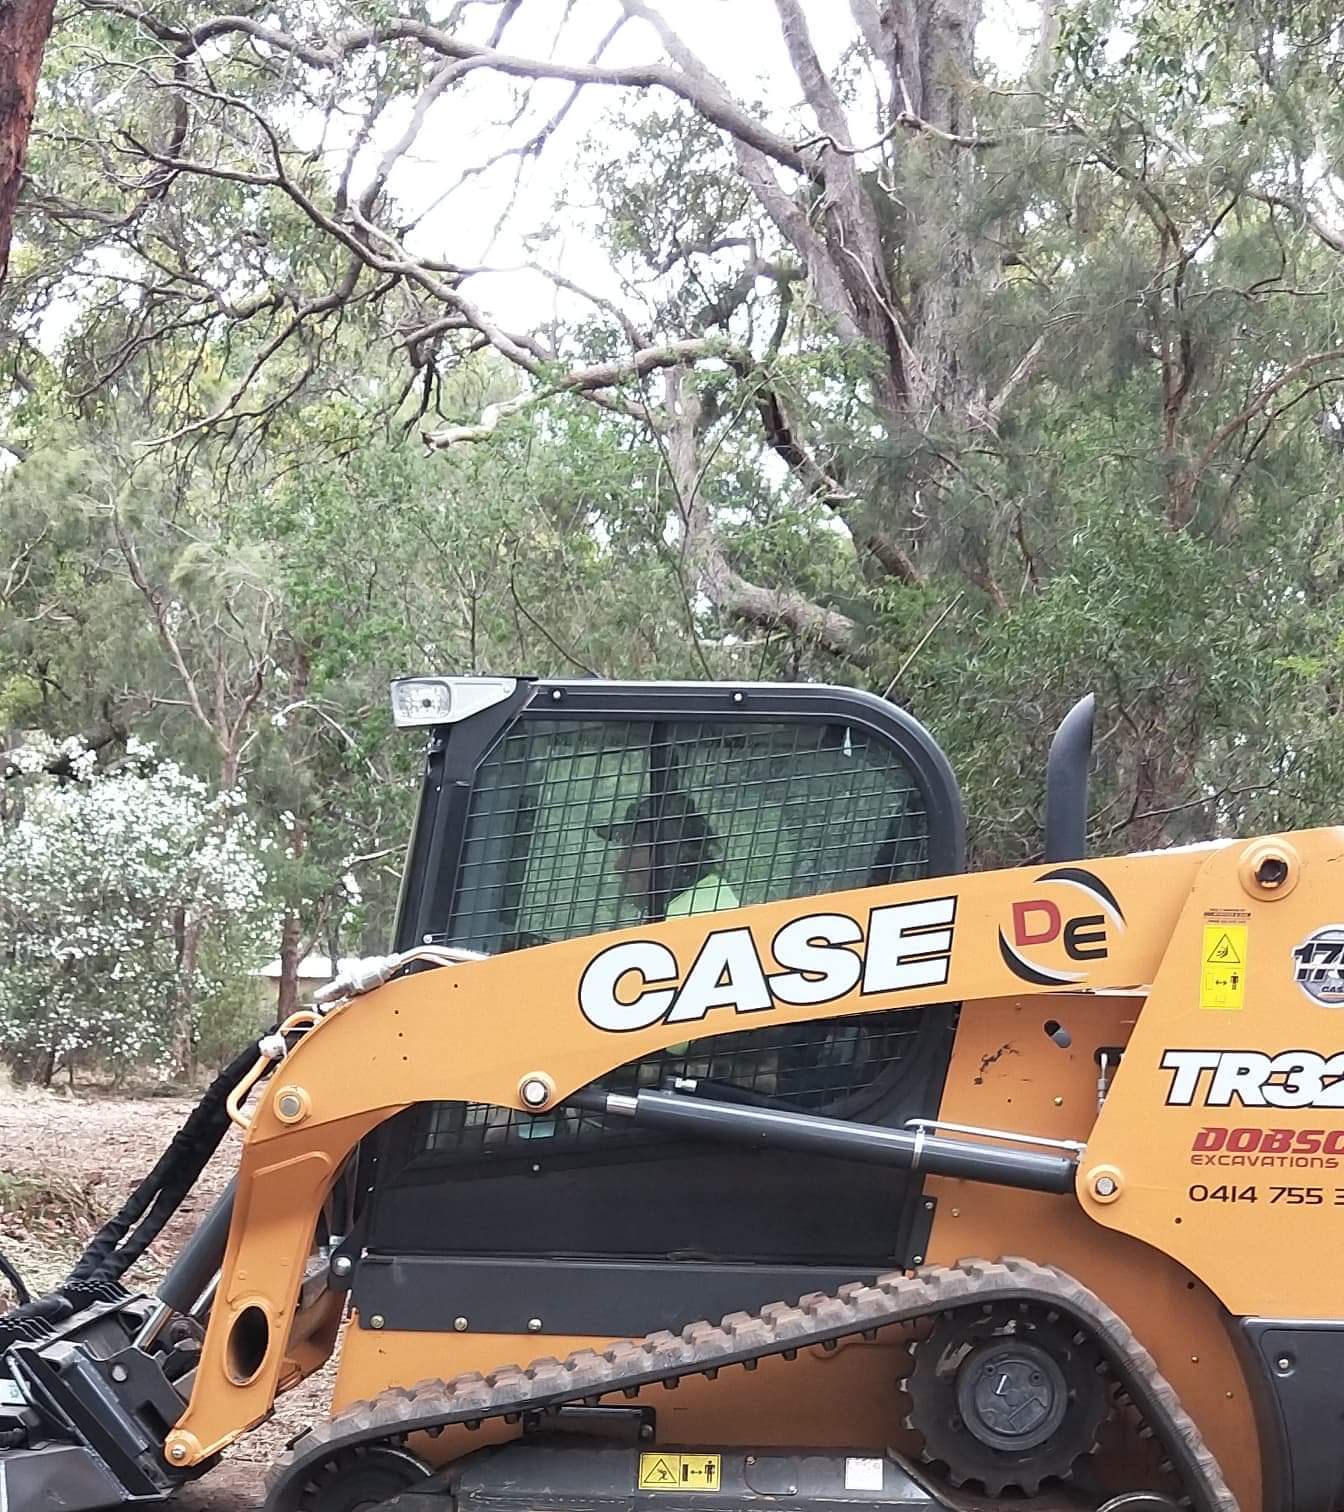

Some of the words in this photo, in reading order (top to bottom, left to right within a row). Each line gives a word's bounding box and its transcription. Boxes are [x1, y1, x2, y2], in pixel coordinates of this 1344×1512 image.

[579, 895, 958, 1033] CASE
[1190, 1154, 1340, 1168] EXCAVATIONS
[1188, 1184, 1258, 1204] 0414
[1269, 1186, 1323, 1205] 755
